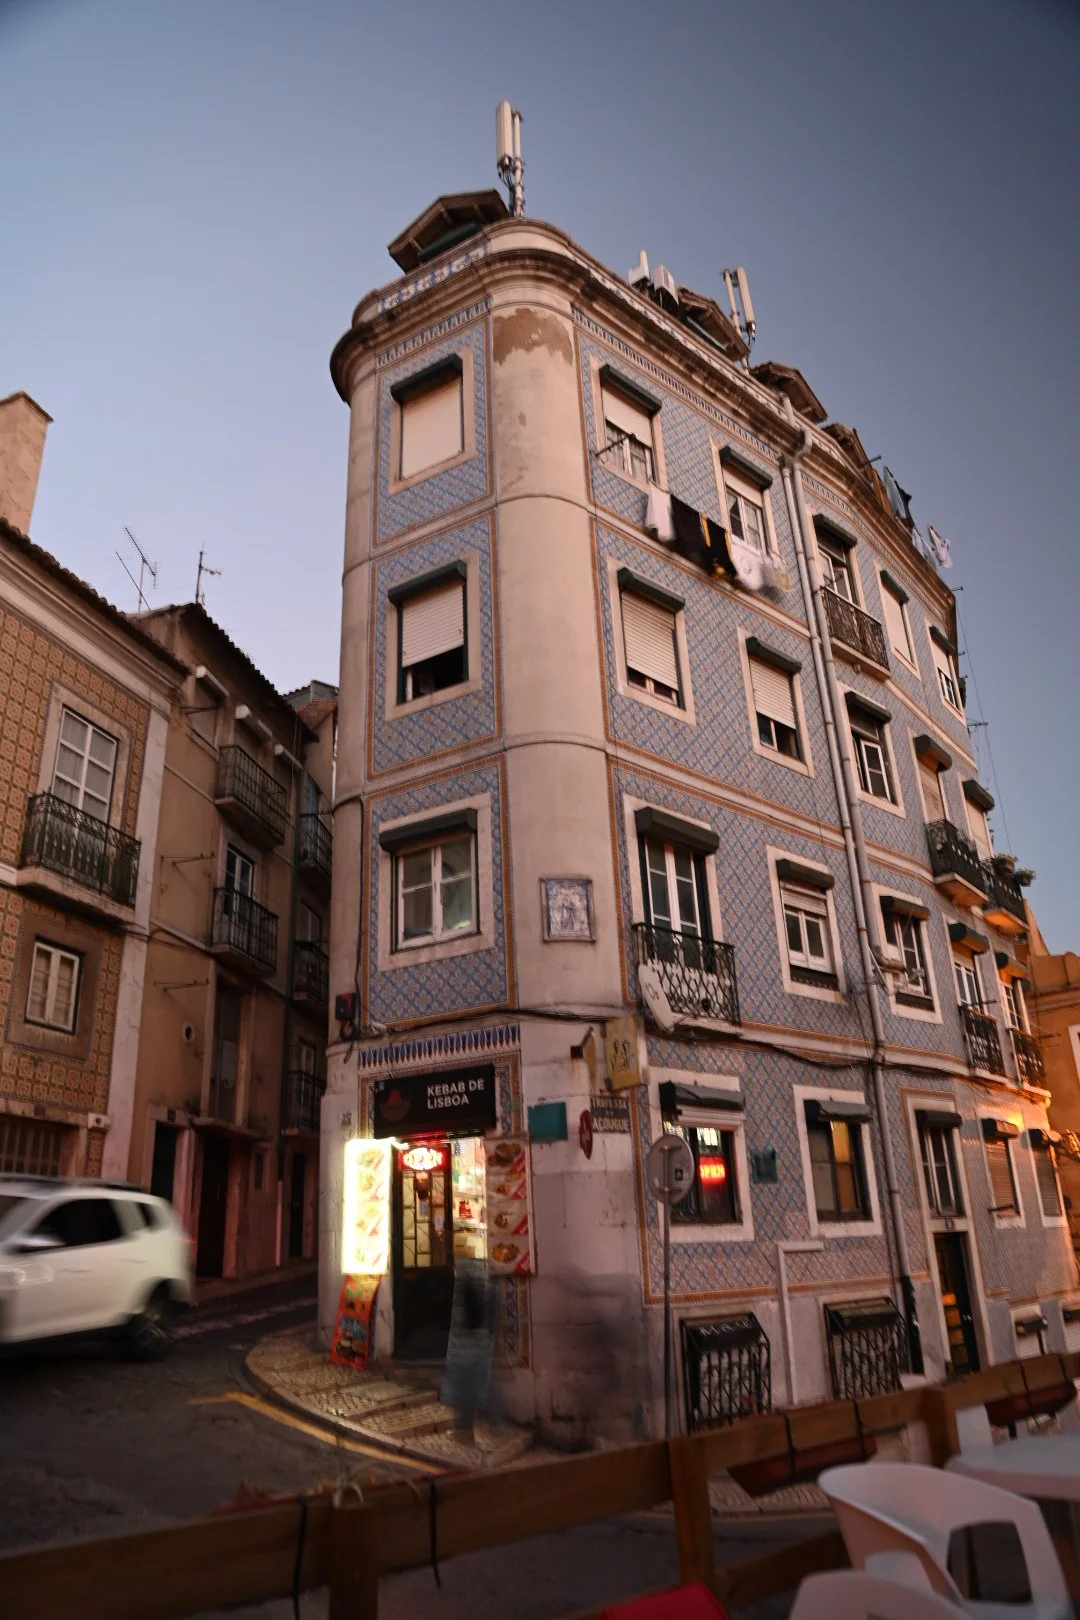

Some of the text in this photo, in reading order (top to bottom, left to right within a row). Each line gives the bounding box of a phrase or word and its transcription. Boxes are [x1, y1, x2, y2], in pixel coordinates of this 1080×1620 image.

[427, 1078, 485, 1097] KEBAB DE
[427, 1094, 469, 1109] LISBOA
[700, 1165, 725, 1178] OPEN
